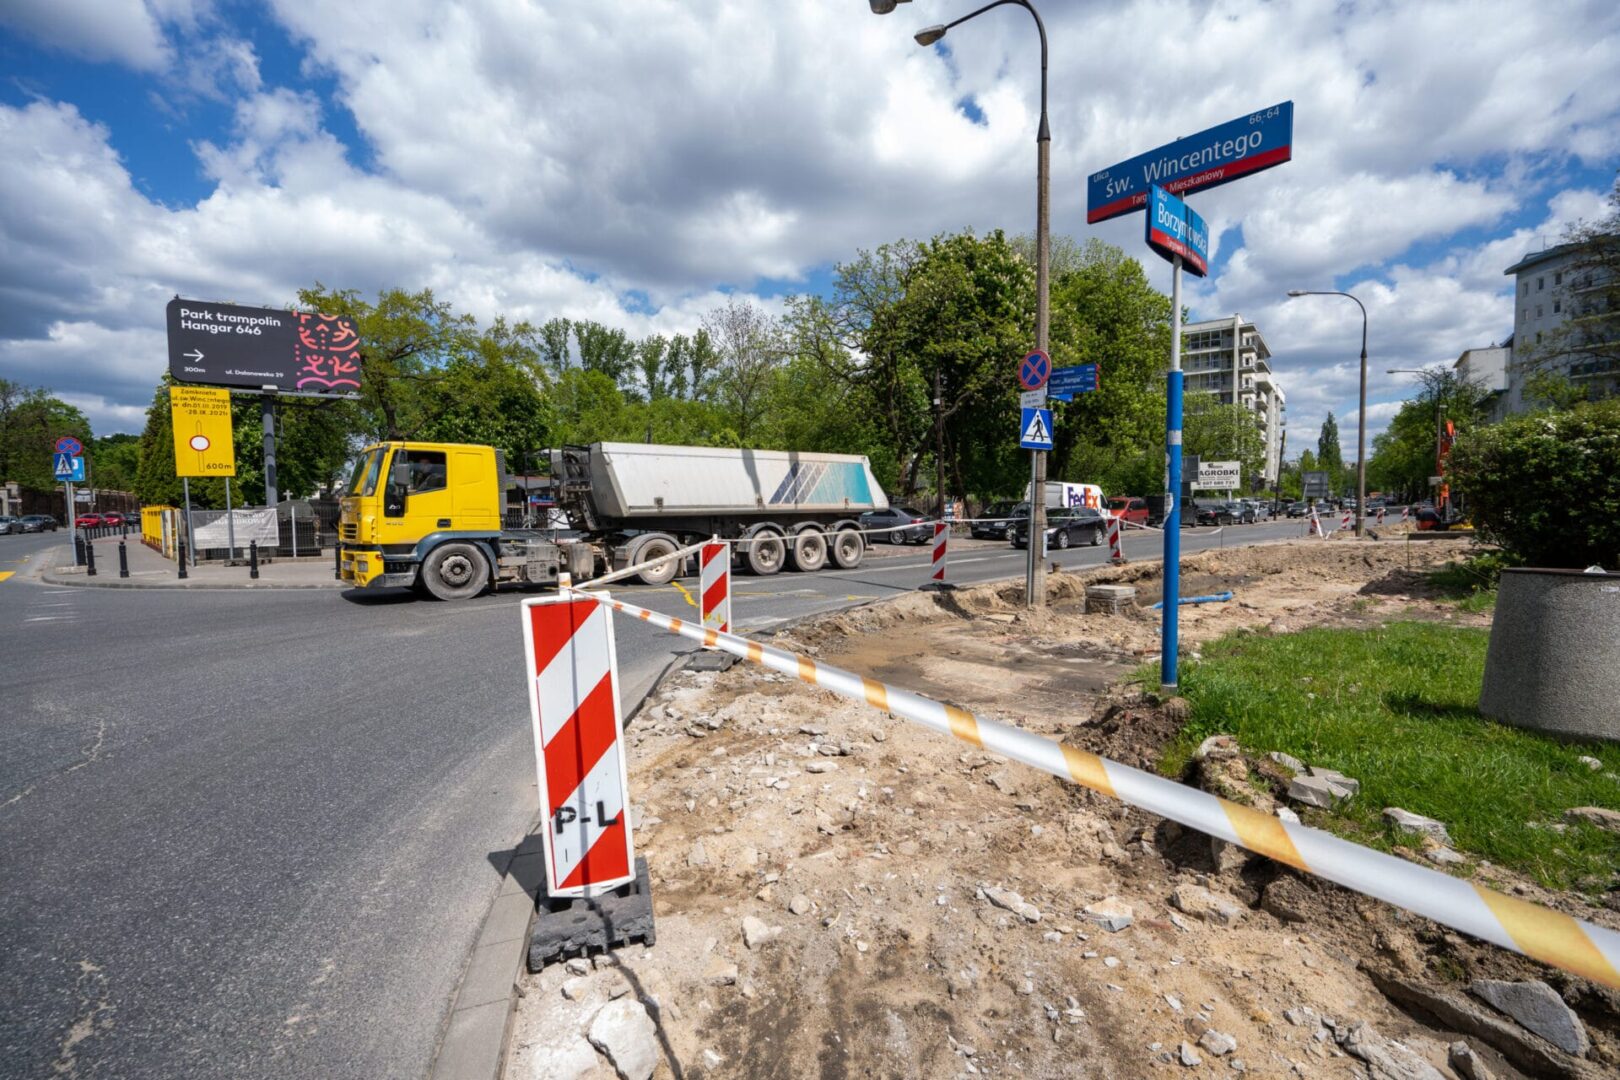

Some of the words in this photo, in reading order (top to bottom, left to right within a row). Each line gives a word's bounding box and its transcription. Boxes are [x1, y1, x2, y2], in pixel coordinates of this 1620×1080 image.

[1249, 106, 1280, 125] 66-64
[1106, 176, 1134, 198] św.
[1143, 131, 1263, 183] Wincentego
[1169, 168, 1225, 192] Mieszkaniowy
[180, 308, 213, 320] Park
[216, 311, 281, 327] trampolin
[181, 319, 233, 335] Hangar
[235, 324, 262, 336] 646
[1067, 486, 1098, 508] FedEx
[555, 800, 618, 834] P-L
